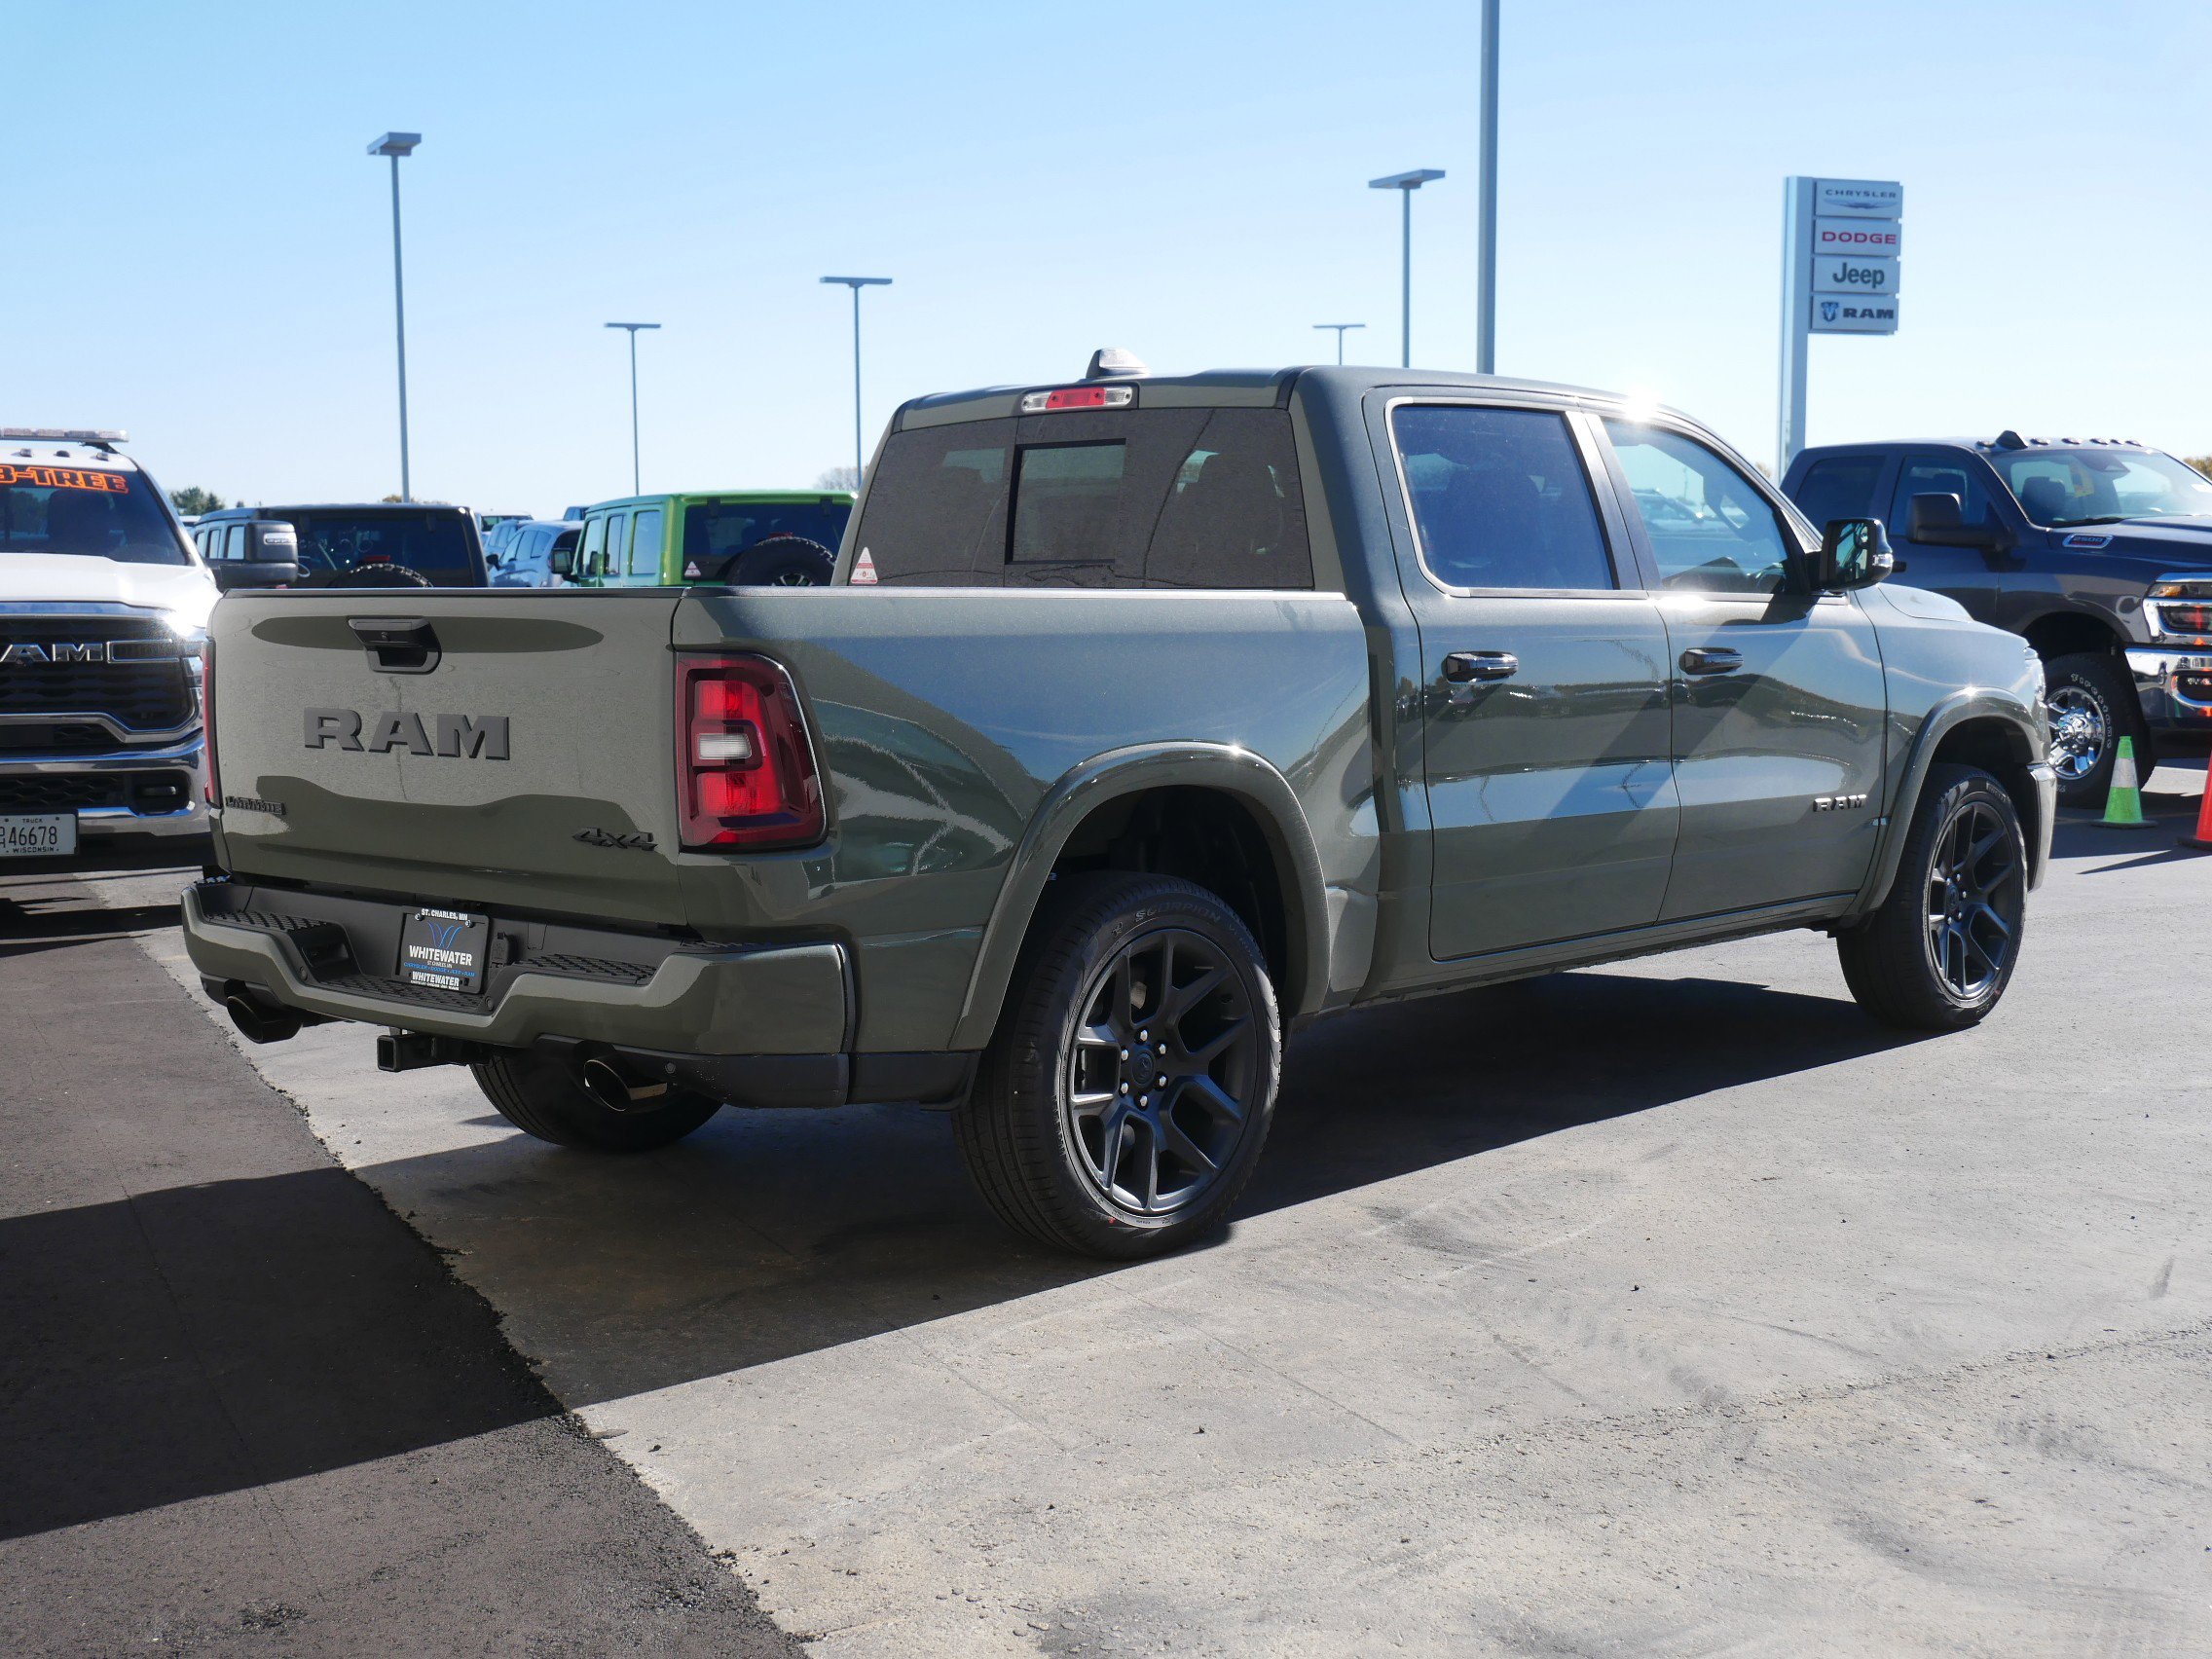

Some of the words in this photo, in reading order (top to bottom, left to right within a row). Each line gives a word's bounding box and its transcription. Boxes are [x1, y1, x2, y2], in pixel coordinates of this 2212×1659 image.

[1825, 189, 1897, 199] CHRYSLER
[1822, 231, 1897, 244] DODGE
[1832, 262, 1885, 288] Jeep
[1843, 308, 1895, 319] RAM
[304, 707, 510, 761] RAM
[1813, 794, 1867, 812] RAM
[431, 909, 458, 920] CHARLES,
[409, 945, 472, 966] WHITEWATER
[412, 971, 460, 986] WHITEWATER
